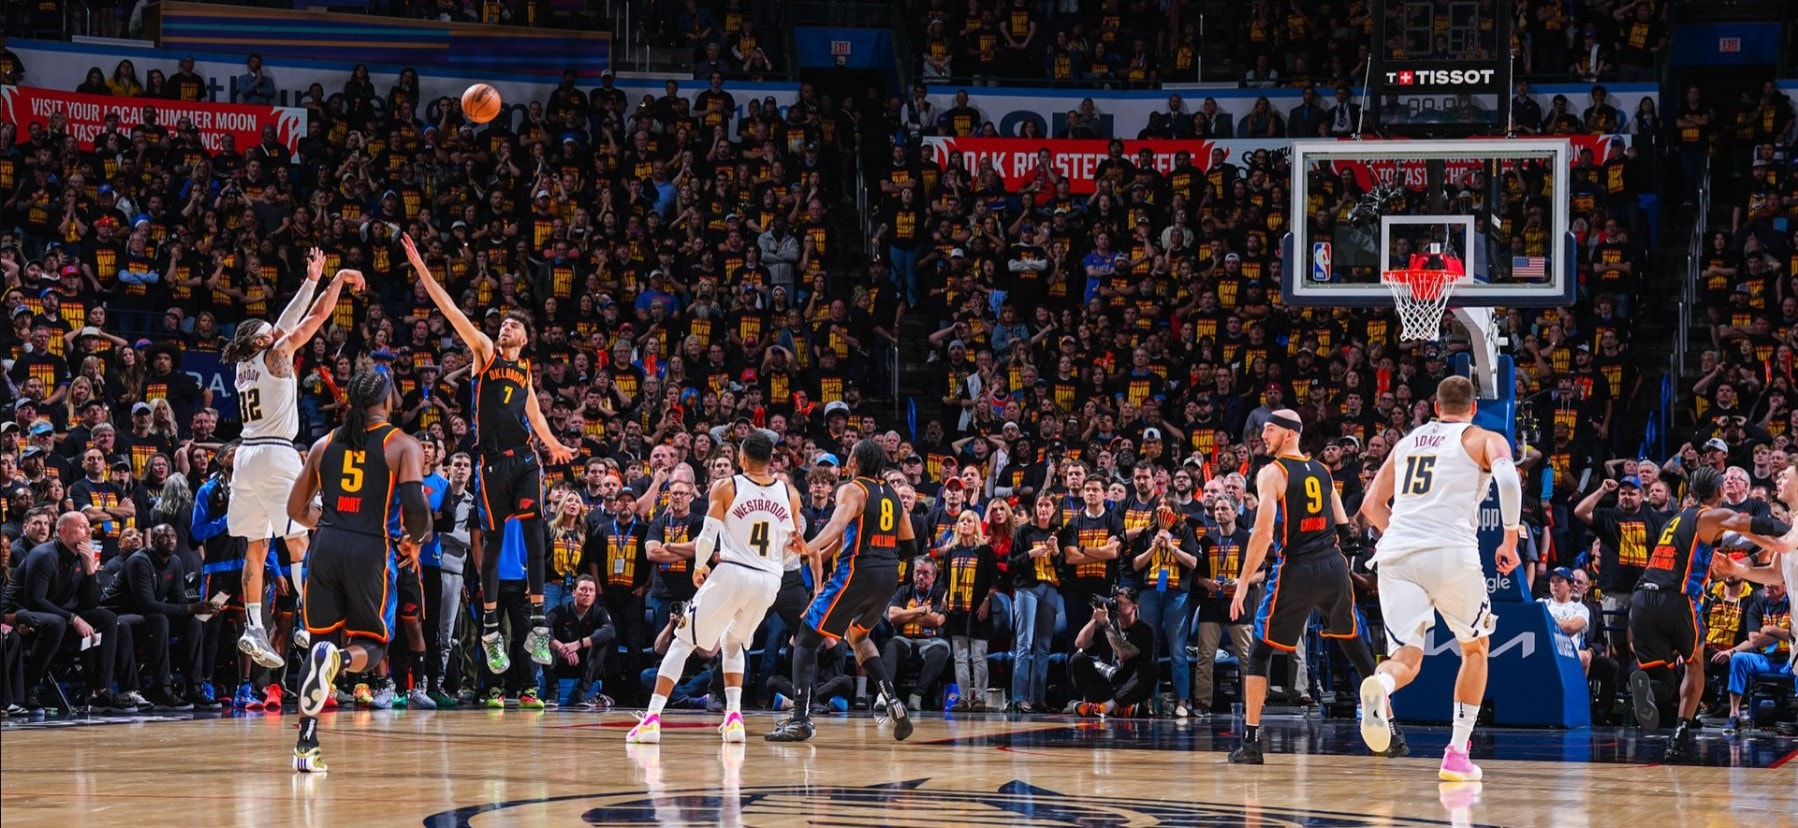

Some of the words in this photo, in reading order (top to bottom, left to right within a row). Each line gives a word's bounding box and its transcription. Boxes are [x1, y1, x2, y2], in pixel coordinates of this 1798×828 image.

[1416, 70, 1494, 85] TISSOT
[31, 97, 63, 117] VISIT
[66, 101, 100, 122] YOUR
[215, 112, 256, 131] MOON
[1014, 151, 1108, 180] ROSTE
[489, 367, 527, 389] OKLAHOMA
[503, 385, 514, 404] 7
[341, 449, 366, 492] 5
[1402, 455, 1436, 495] 15
[337, 496, 361, 513] DORT
[1305, 476, 1322, 514] 9
[732, 499, 789, 522] WESTBROOK
[880, 498, 894, 532] 8
[749, 521, 770, 557] 4
[1657, 516, 1680, 545] 2
